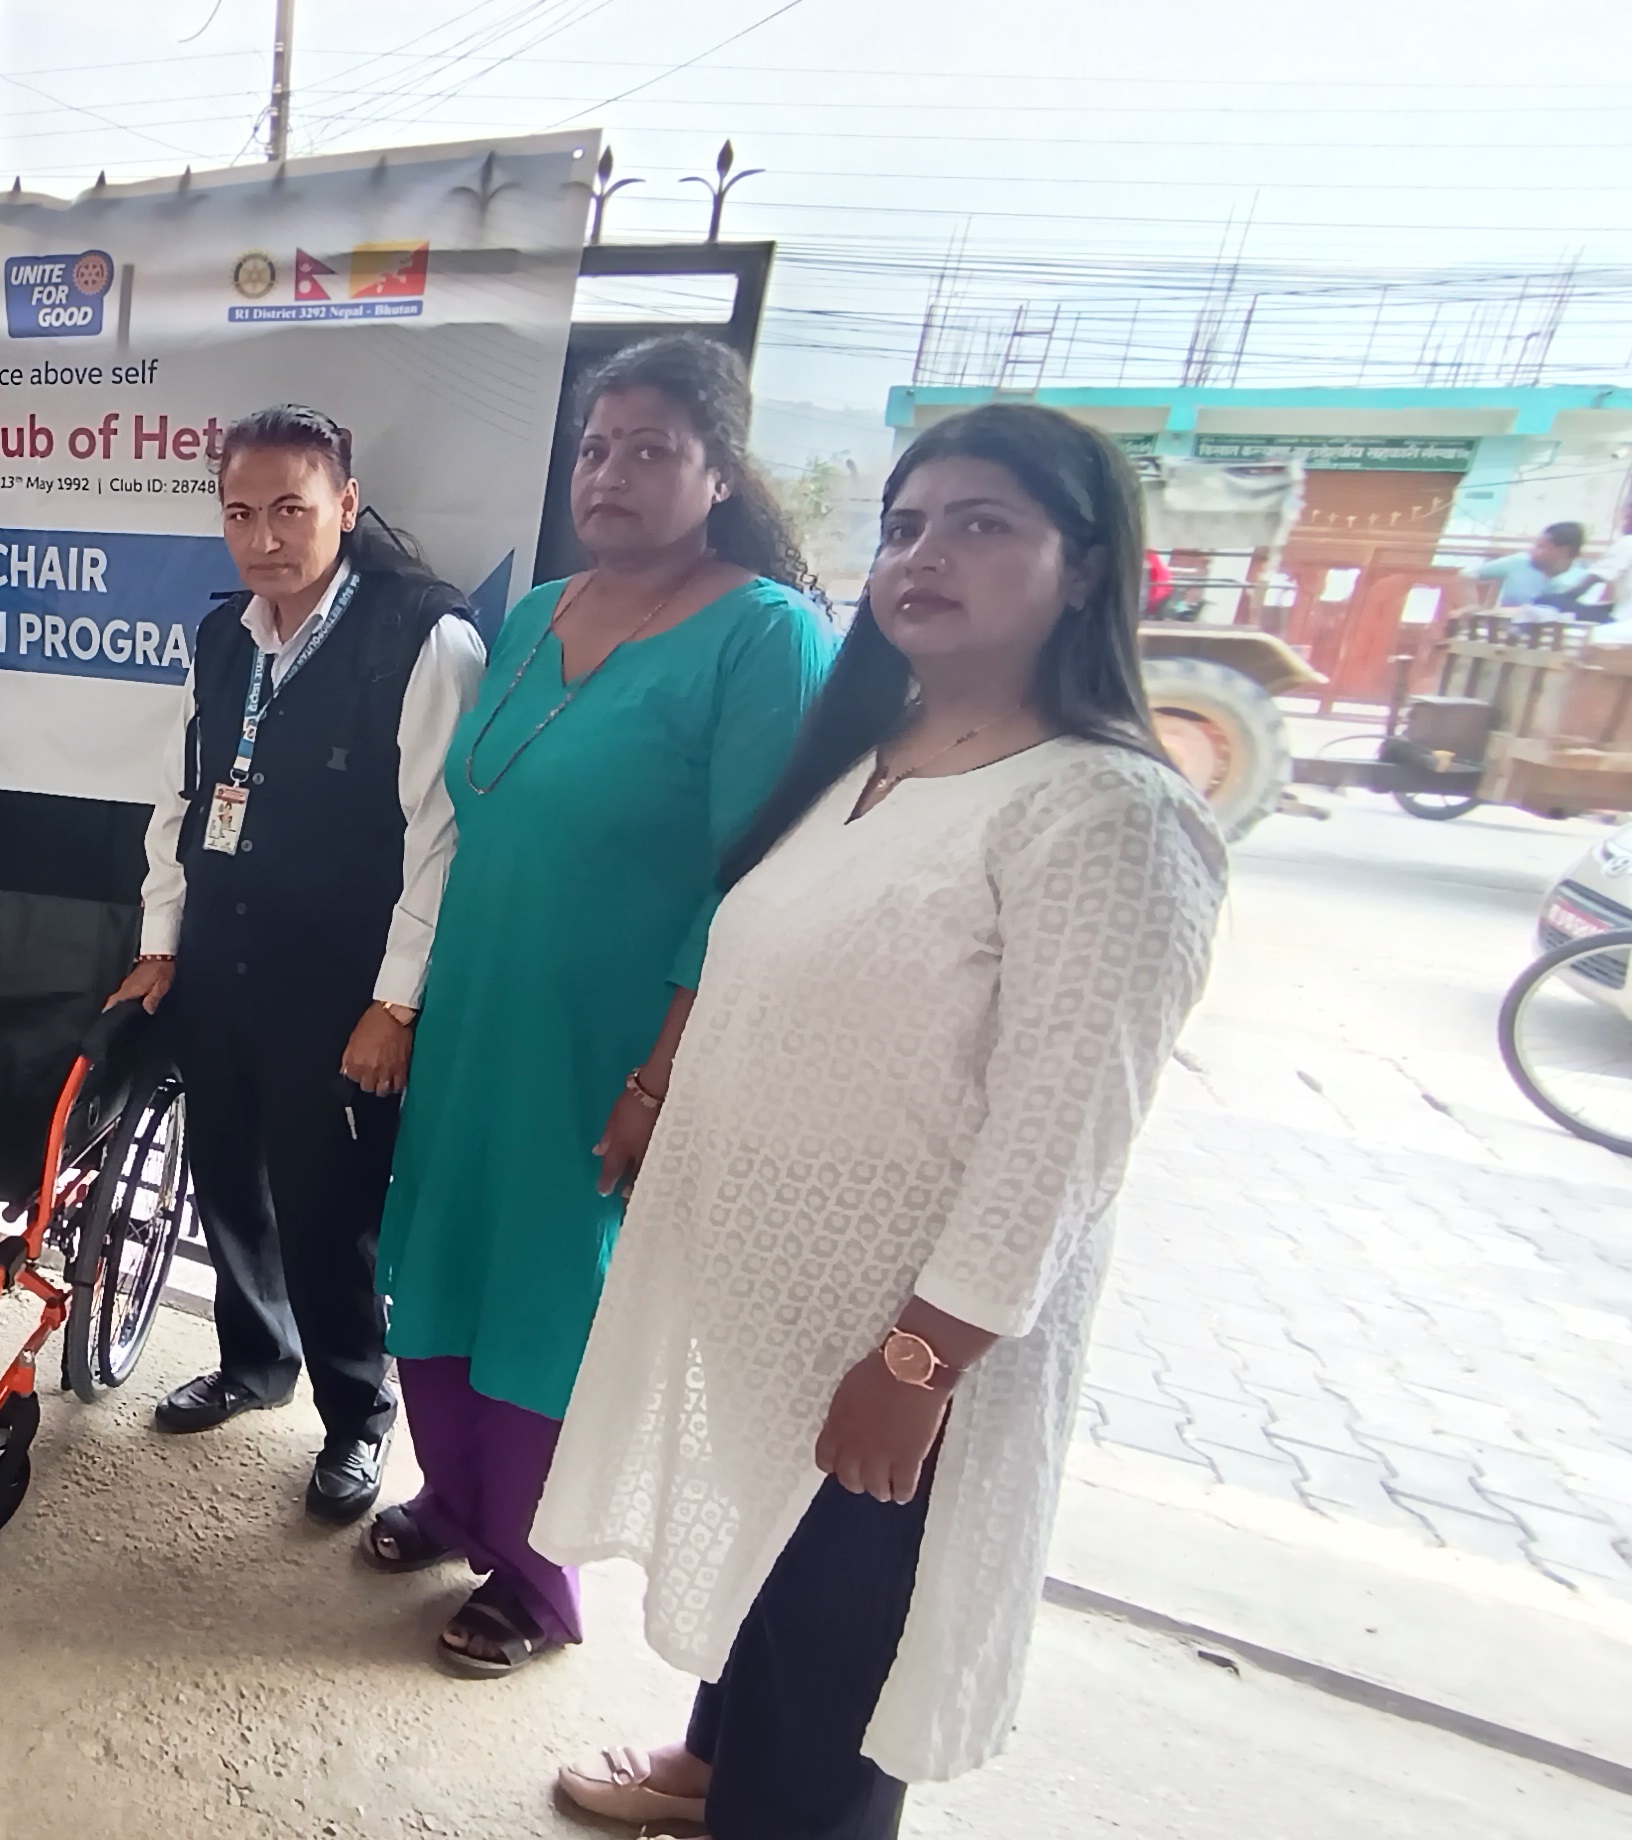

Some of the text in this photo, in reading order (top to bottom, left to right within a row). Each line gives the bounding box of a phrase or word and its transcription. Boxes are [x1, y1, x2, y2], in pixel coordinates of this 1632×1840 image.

[11, 264, 66, 285] UNITE
[32, 285, 69, 305] FOR
[38, 306, 93, 327] GOOD
[253, 307, 296, 319] District
[299, 306, 326, 319] 3292
[330, 304, 364, 319] Nepal
[375, 303, 418, 316] Bhutan
[30, 361, 103, 385] above
[111, 358, 158, 384] self
[68, 413, 119, 460] of
[134, 415, 223, 461] Het
[26, 476, 54, 494] May
[57, 477, 89, 491] 1992
[109, 477, 143, 492] Club
[147, 478, 167, 493] ID:
[171, 479, 216, 494] 28748
[19, 613, 191, 668] PROGRA
